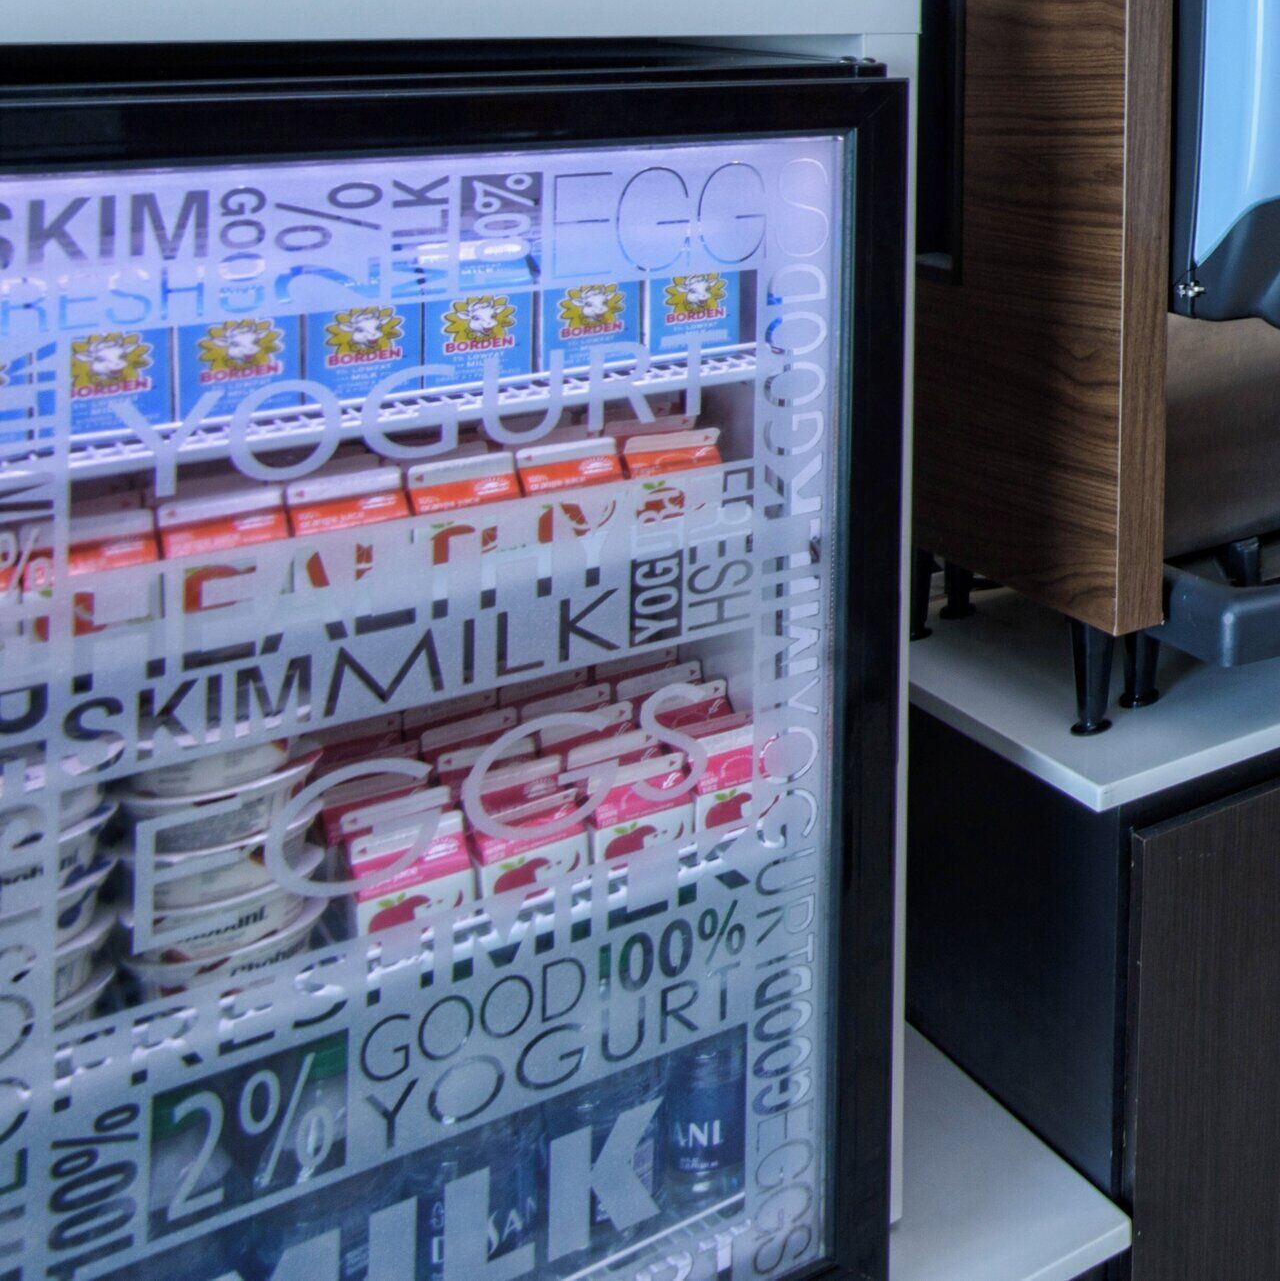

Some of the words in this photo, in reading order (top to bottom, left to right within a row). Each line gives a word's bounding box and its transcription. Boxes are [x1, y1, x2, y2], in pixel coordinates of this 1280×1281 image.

[217, 185, 267, 313] GOOD
[553, 159, 829, 278] EGGS
[0, 264, 205, 334] RESH
[328, 349, 402, 366] BORDEN
[446, 336, 514, 353] BORDEN
[561, 322, 623, 338] BORDEN
[666, 308, 724, 323] BORDEN
[763, 263, 829, 456] GOOD
[108, 327, 728, 499] YOGURT
[200, 363, 279, 383] BORDEN
[62, 654, 312, 772] SKIM
[322, 587, 621, 719] MILK
[133, 683, 707, 956] EGGS
[452, 823, 752, 983] MILK
[599, 899, 746, 1000] 100%
[360, 957, 586, 1081] GOOD
[366, 961, 742, 1149] YOGURT
[46, 1102, 140, 1281] 100%
[168, 1051, 335, 1221] 2%
